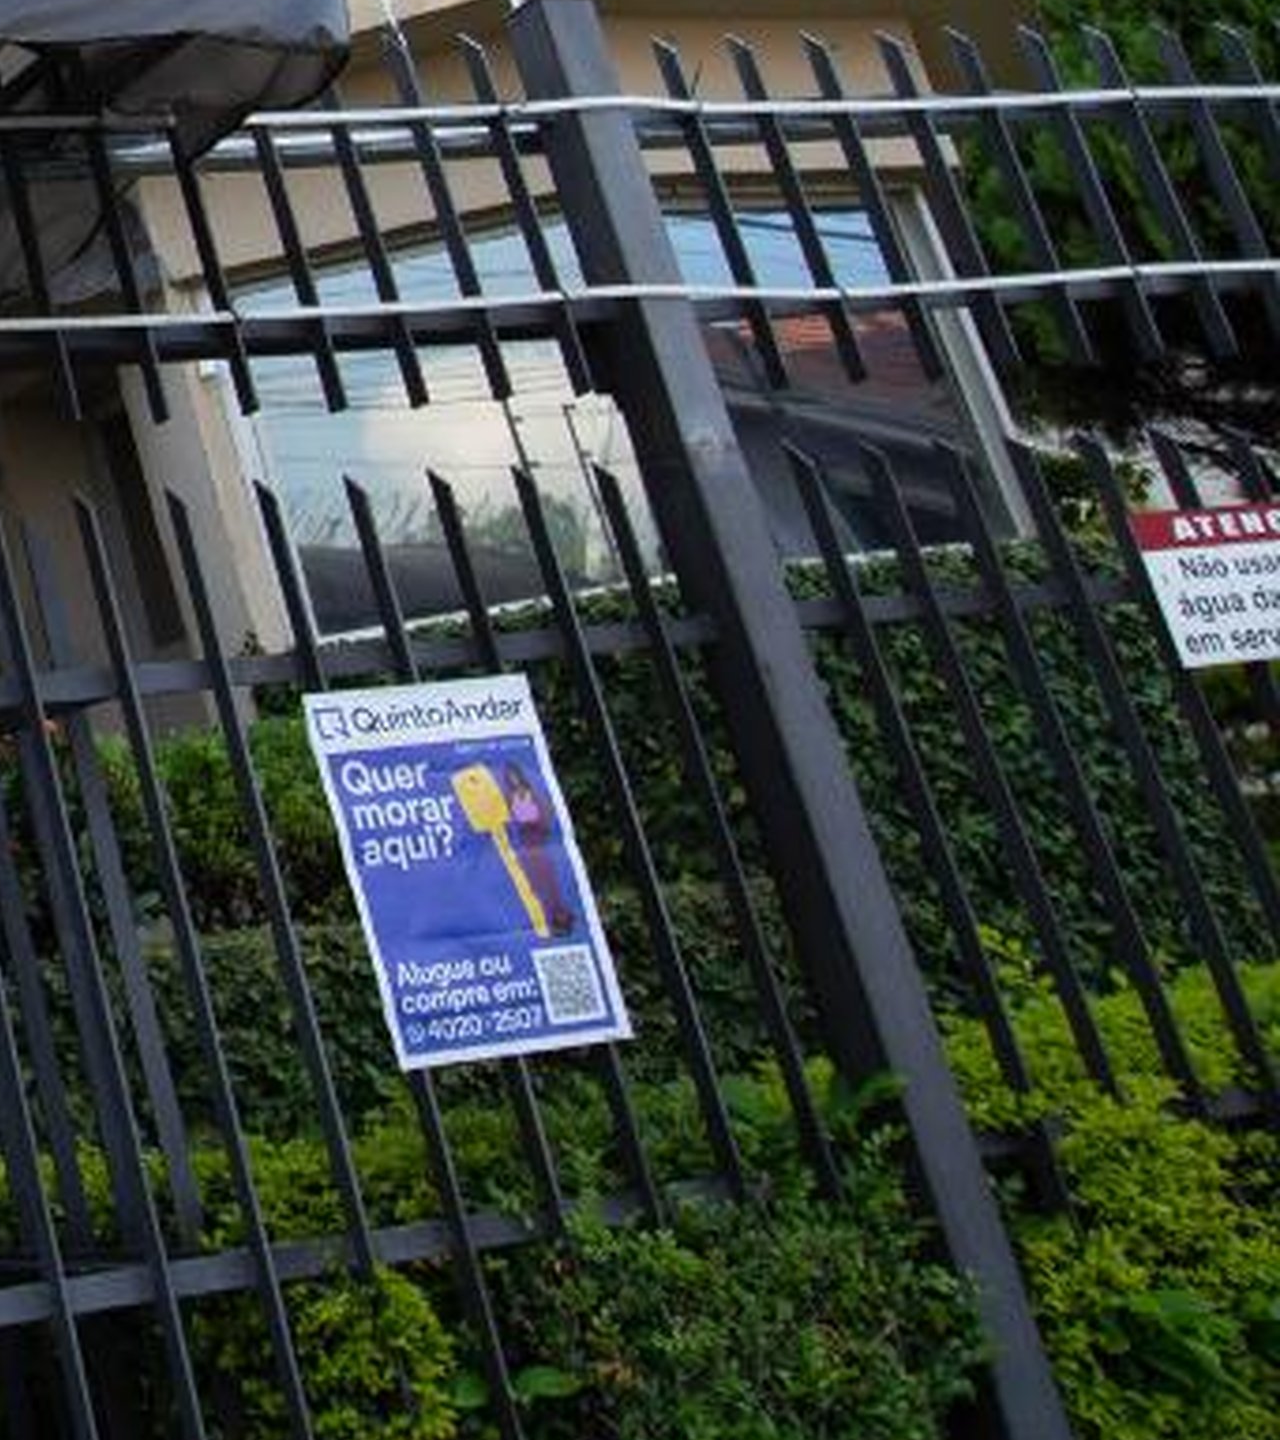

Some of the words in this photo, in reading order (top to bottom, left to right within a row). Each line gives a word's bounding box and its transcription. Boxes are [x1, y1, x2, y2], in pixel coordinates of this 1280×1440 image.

[1178, 554, 1229, 579] Não
[1235, 552, 1280, 576] usa
[1178, 591, 1247, 623] água
[1185, 631, 1225, 654] em
[350, 693, 524, 733] QuintoAndar
[340, 760, 429, 797] Quer
[352, 793, 455, 831] morar
[362, 826, 455, 870] aqui?
[479, 953, 513, 976] ou
[401, 983, 491, 1014] compre
